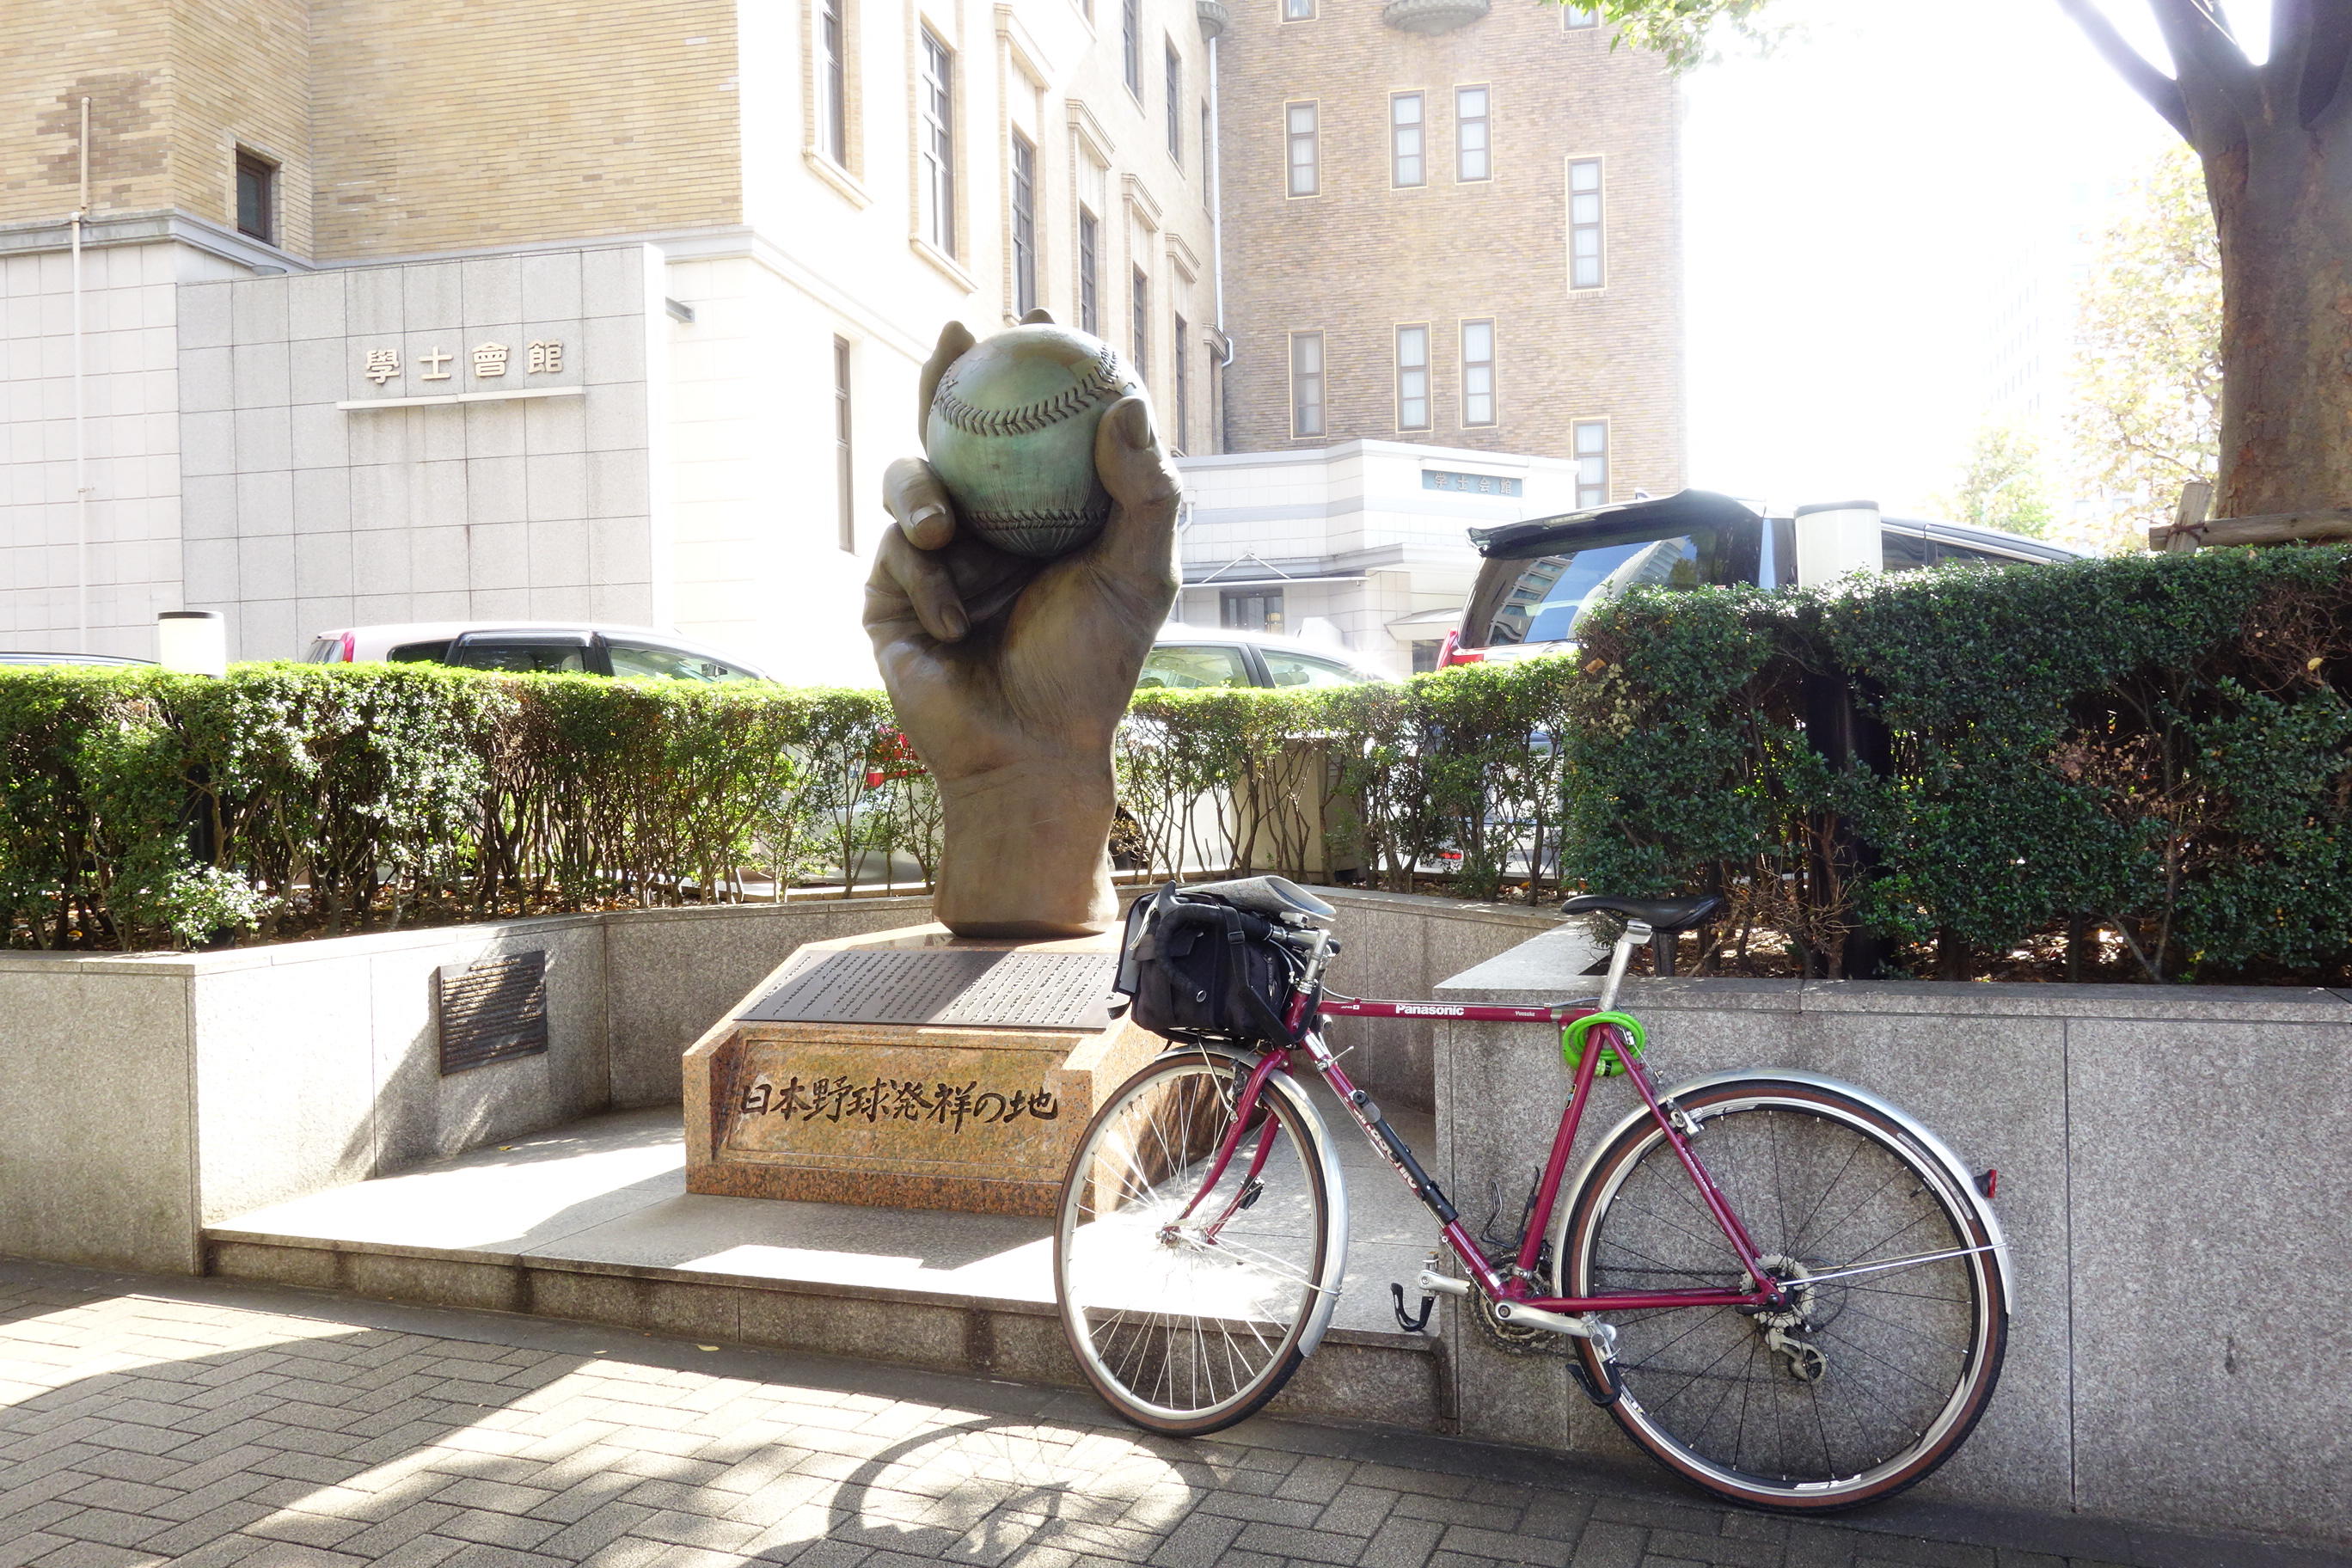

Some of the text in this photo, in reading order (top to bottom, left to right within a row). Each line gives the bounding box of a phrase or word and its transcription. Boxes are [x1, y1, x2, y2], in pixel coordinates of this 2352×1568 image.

[365, 338, 563, 384] 學士會館
[1435, 473, 1512, 495] 学士会館
[1395, 1003, 1465, 1016] Panasonic
[738, 1075, 1060, 1135] 日本野球発祥の地
